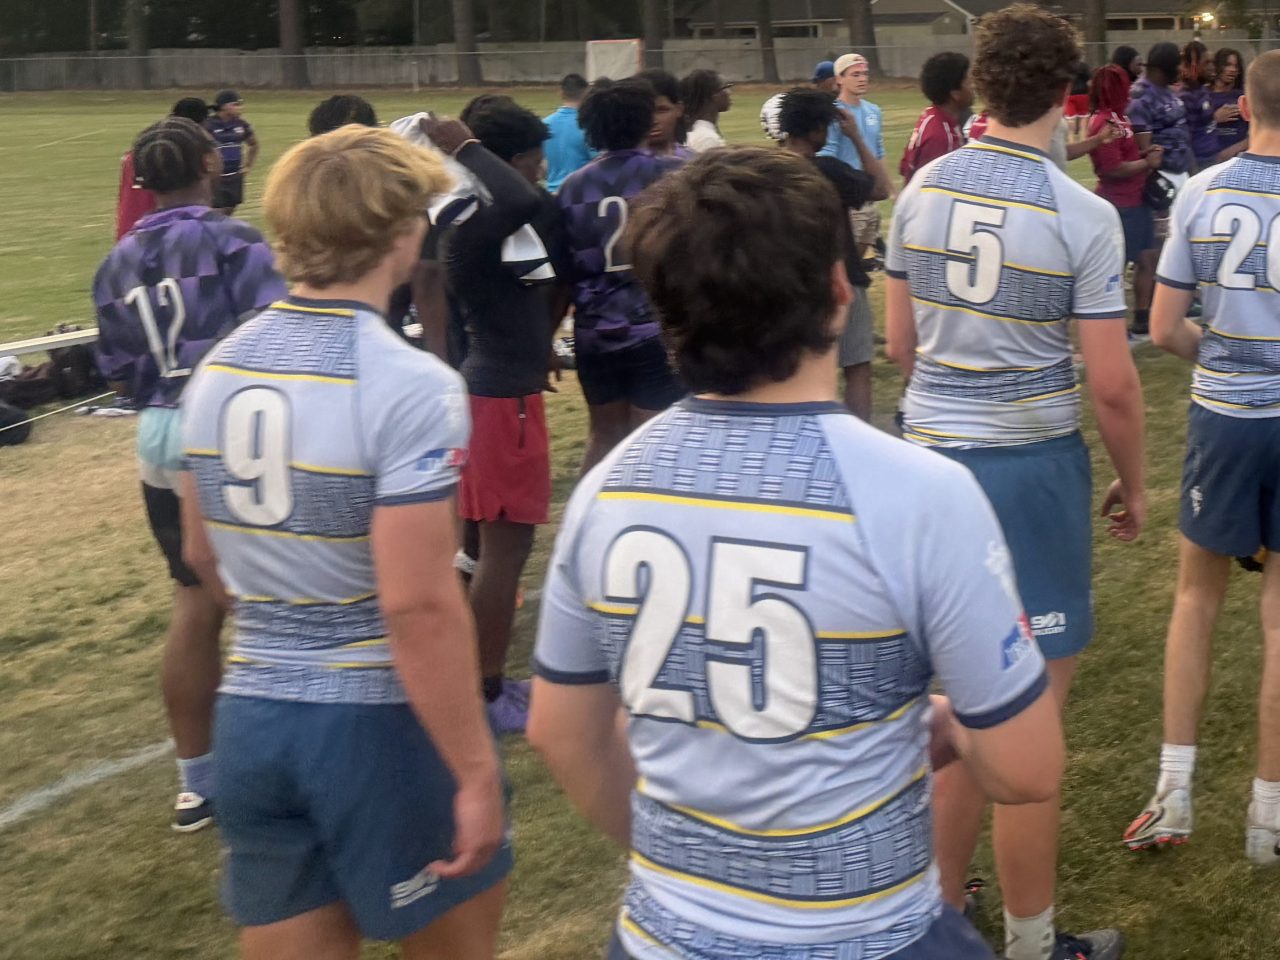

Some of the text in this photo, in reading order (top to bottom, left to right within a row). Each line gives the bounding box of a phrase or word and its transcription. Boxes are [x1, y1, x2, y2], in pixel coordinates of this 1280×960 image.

[945, 199, 1007, 305] 5
[123, 278, 192, 377] 12
[217, 385, 293, 526] 9
[603, 525, 818, 744] 25
